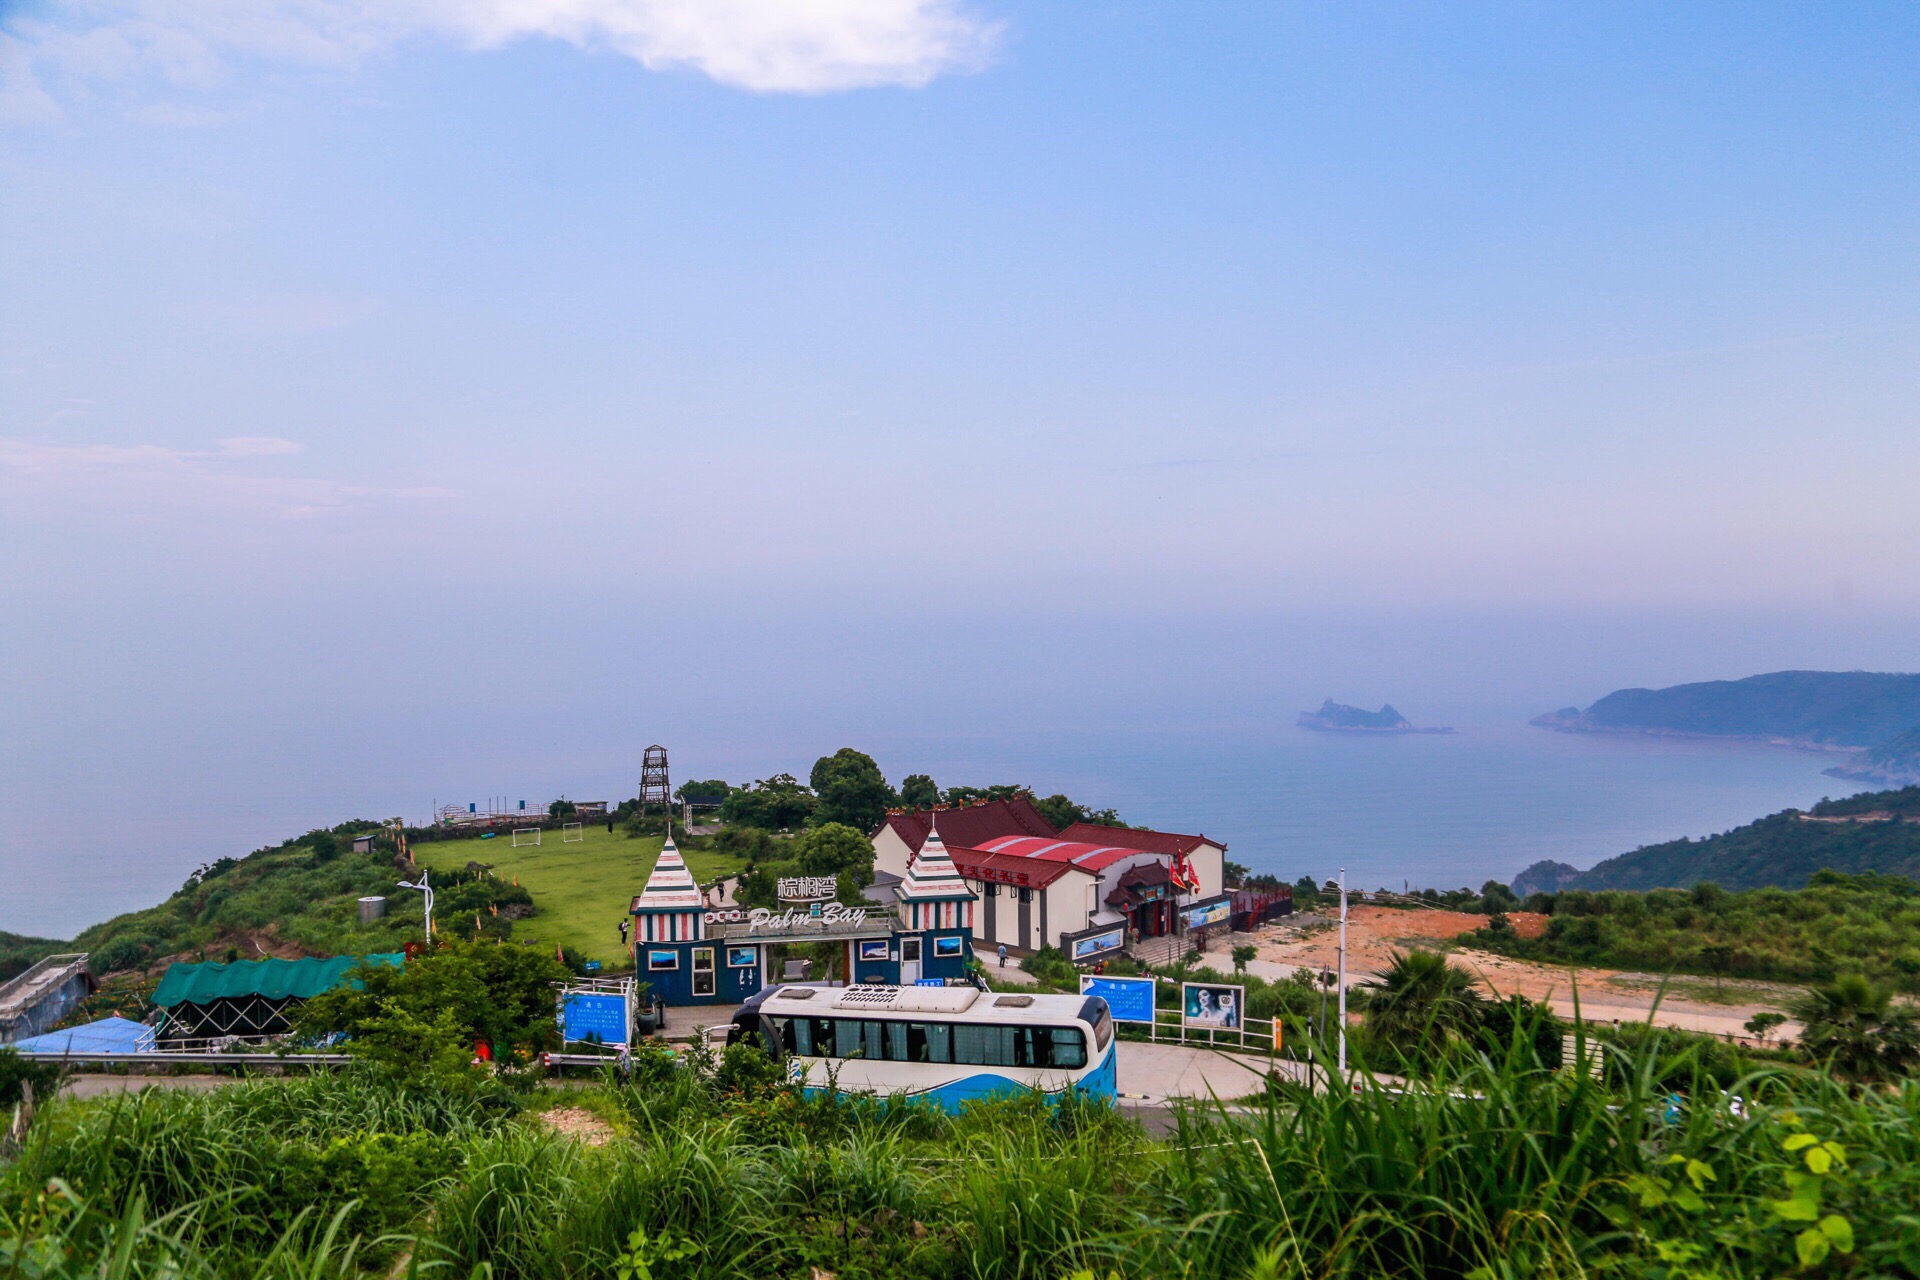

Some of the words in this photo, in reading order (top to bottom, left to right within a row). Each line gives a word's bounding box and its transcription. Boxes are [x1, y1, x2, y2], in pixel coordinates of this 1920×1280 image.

[777, 876, 837, 900] 棕榈湾
[750, 907, 811, 933] Palm
[821, 902, 867, 928] Bay
